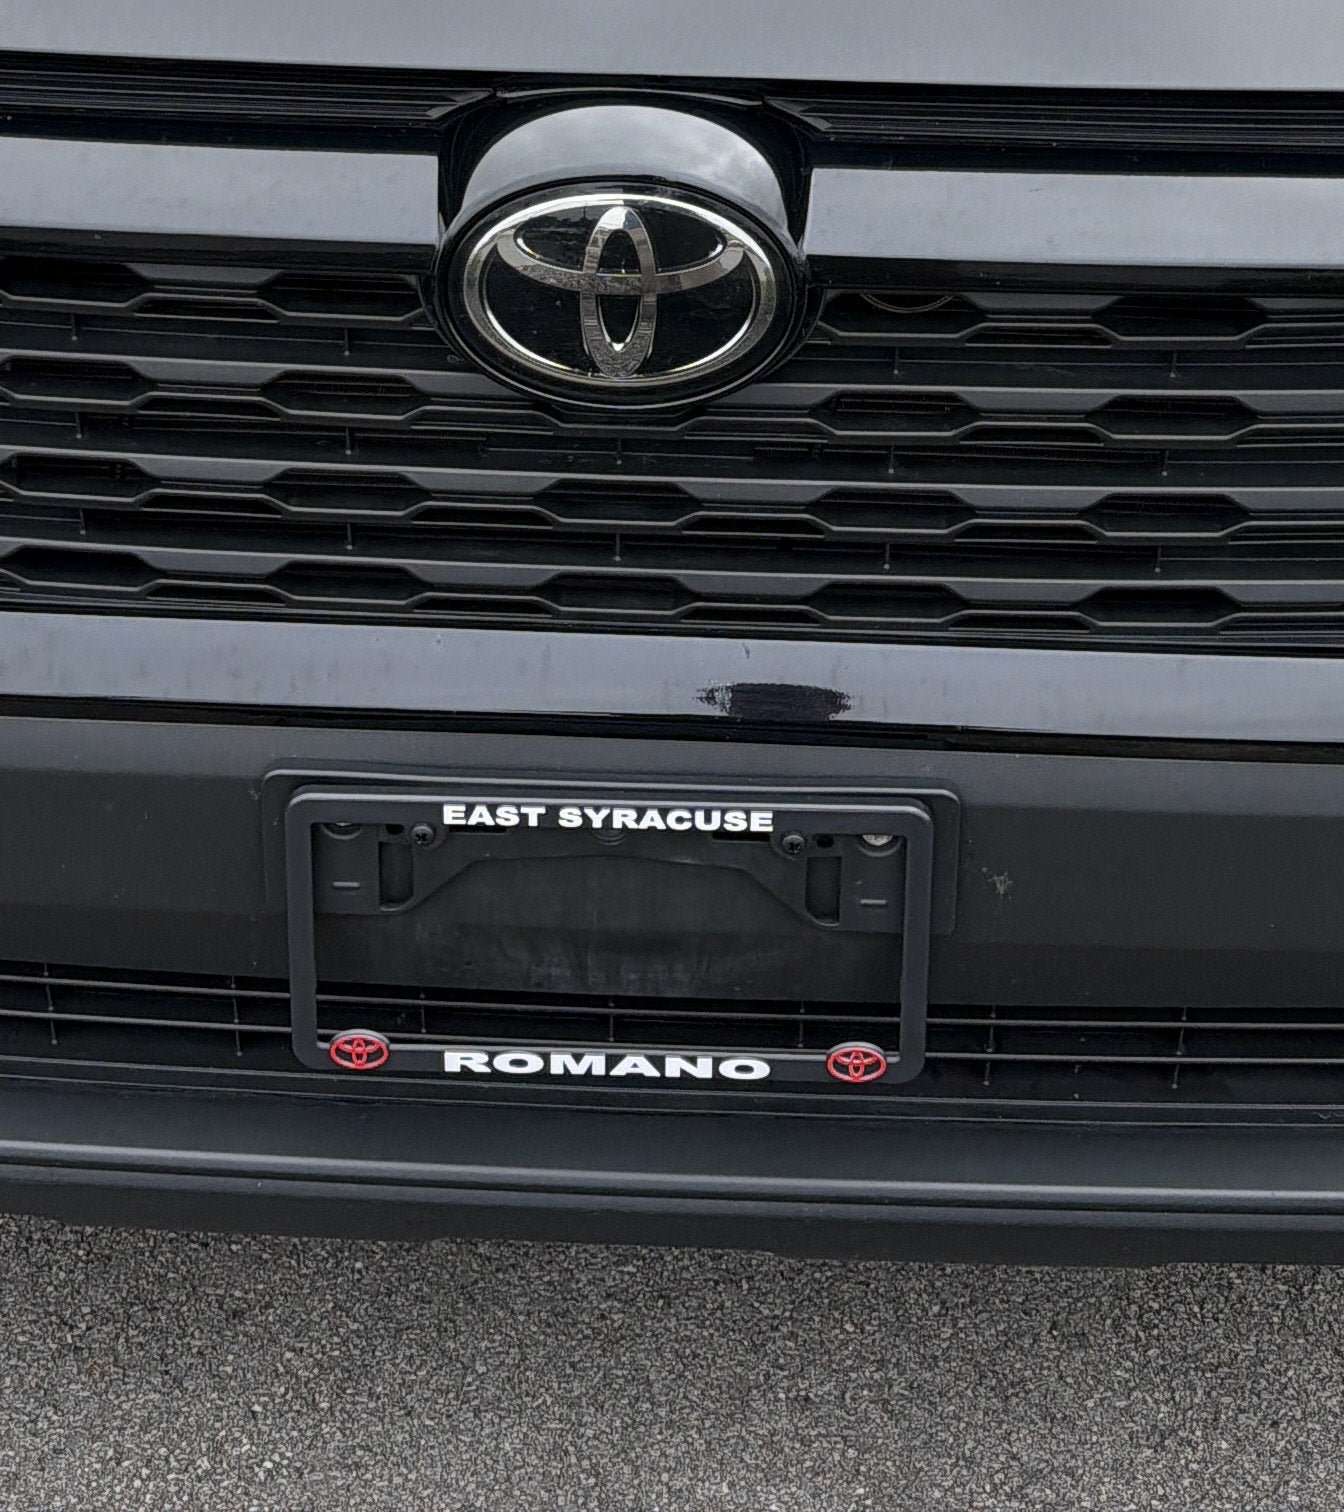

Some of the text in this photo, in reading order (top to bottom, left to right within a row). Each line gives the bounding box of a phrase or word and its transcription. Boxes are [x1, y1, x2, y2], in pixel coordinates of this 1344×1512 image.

[443, 804, 774, 833] EAST SYRACUSE
[444, 1050, 771, 1080] ROMANO
